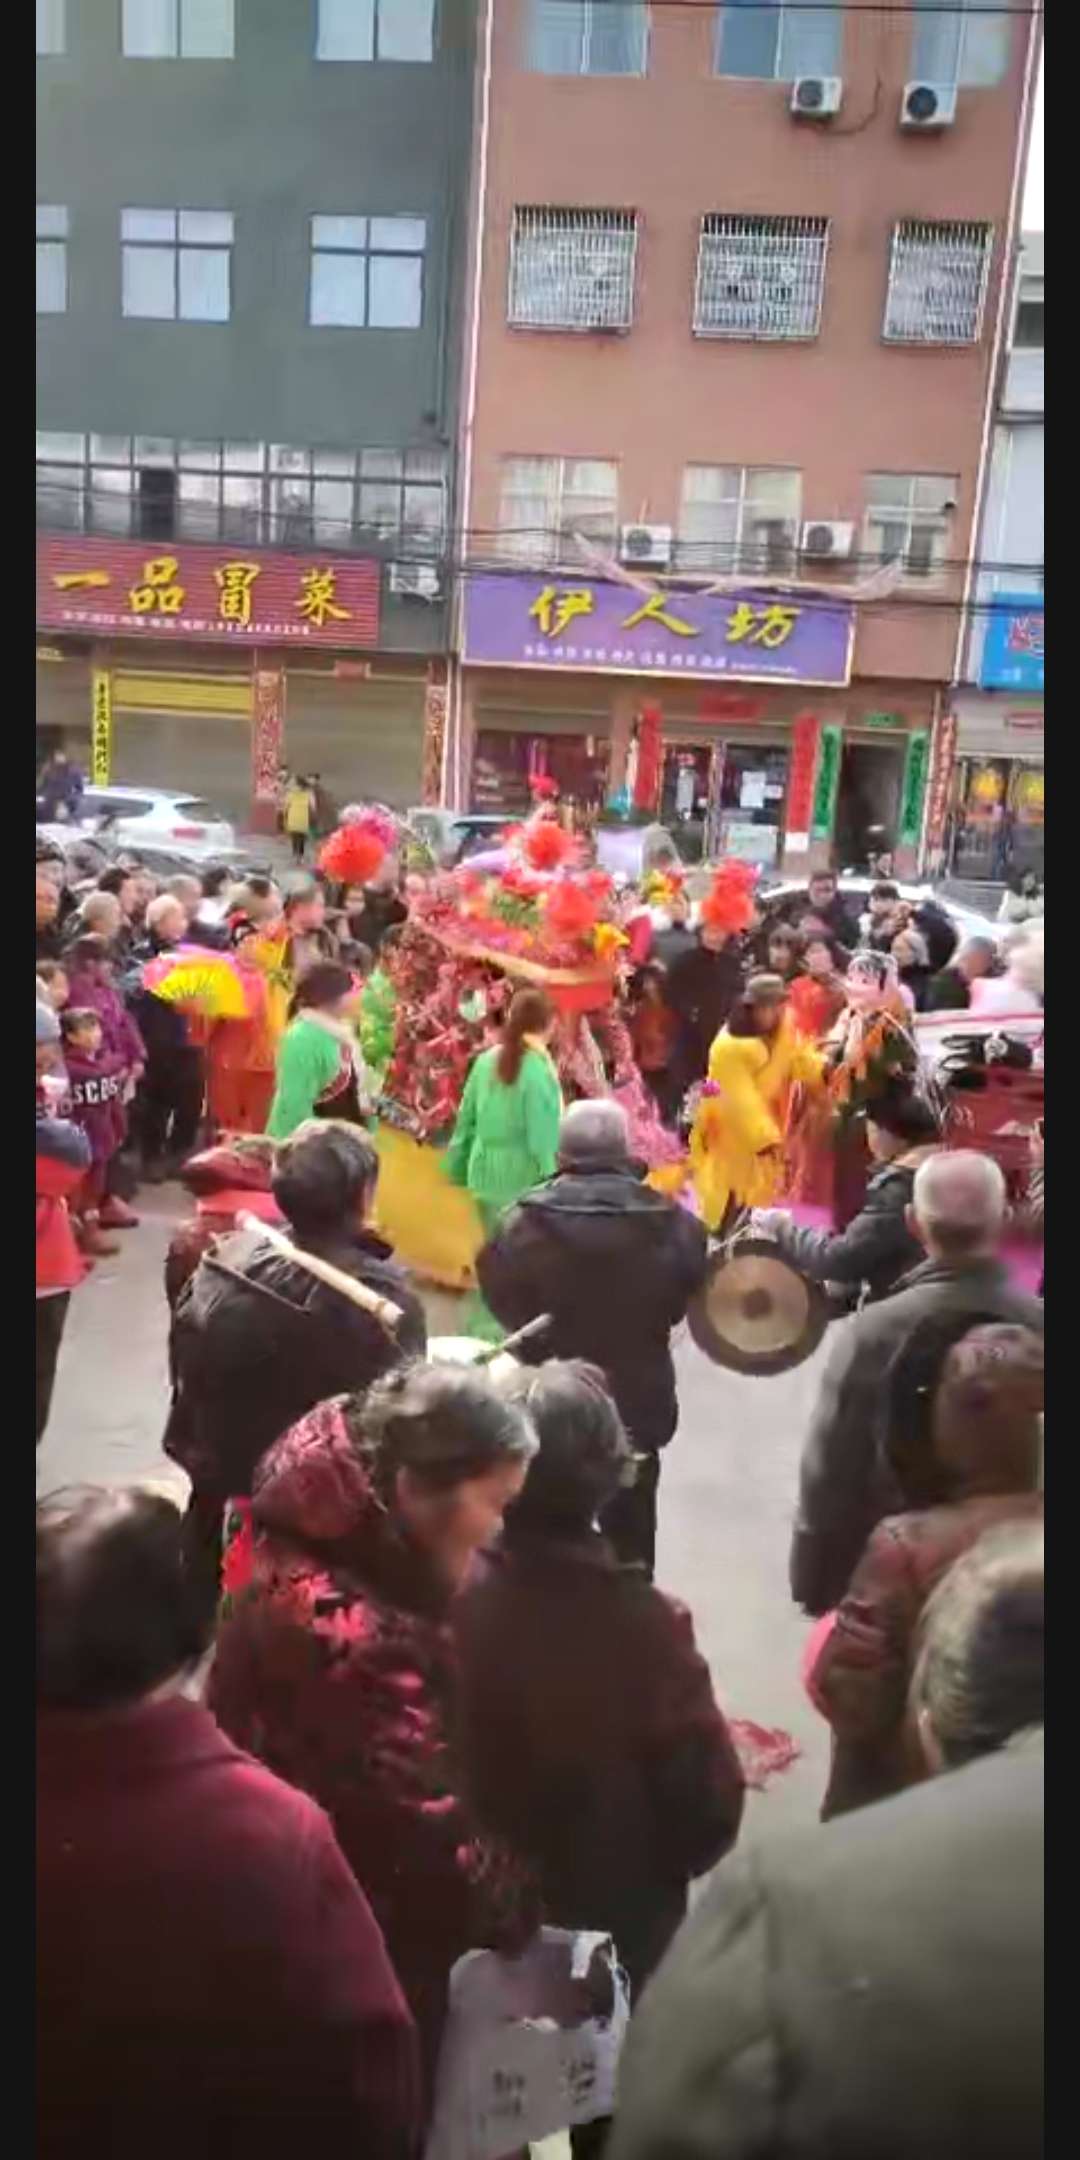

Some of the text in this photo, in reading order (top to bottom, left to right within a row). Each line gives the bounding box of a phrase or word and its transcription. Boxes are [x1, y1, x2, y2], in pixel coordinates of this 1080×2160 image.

[52, 556, 353, 626] 一品冒菜
[529, 585, 801, 648] 伊人坊
